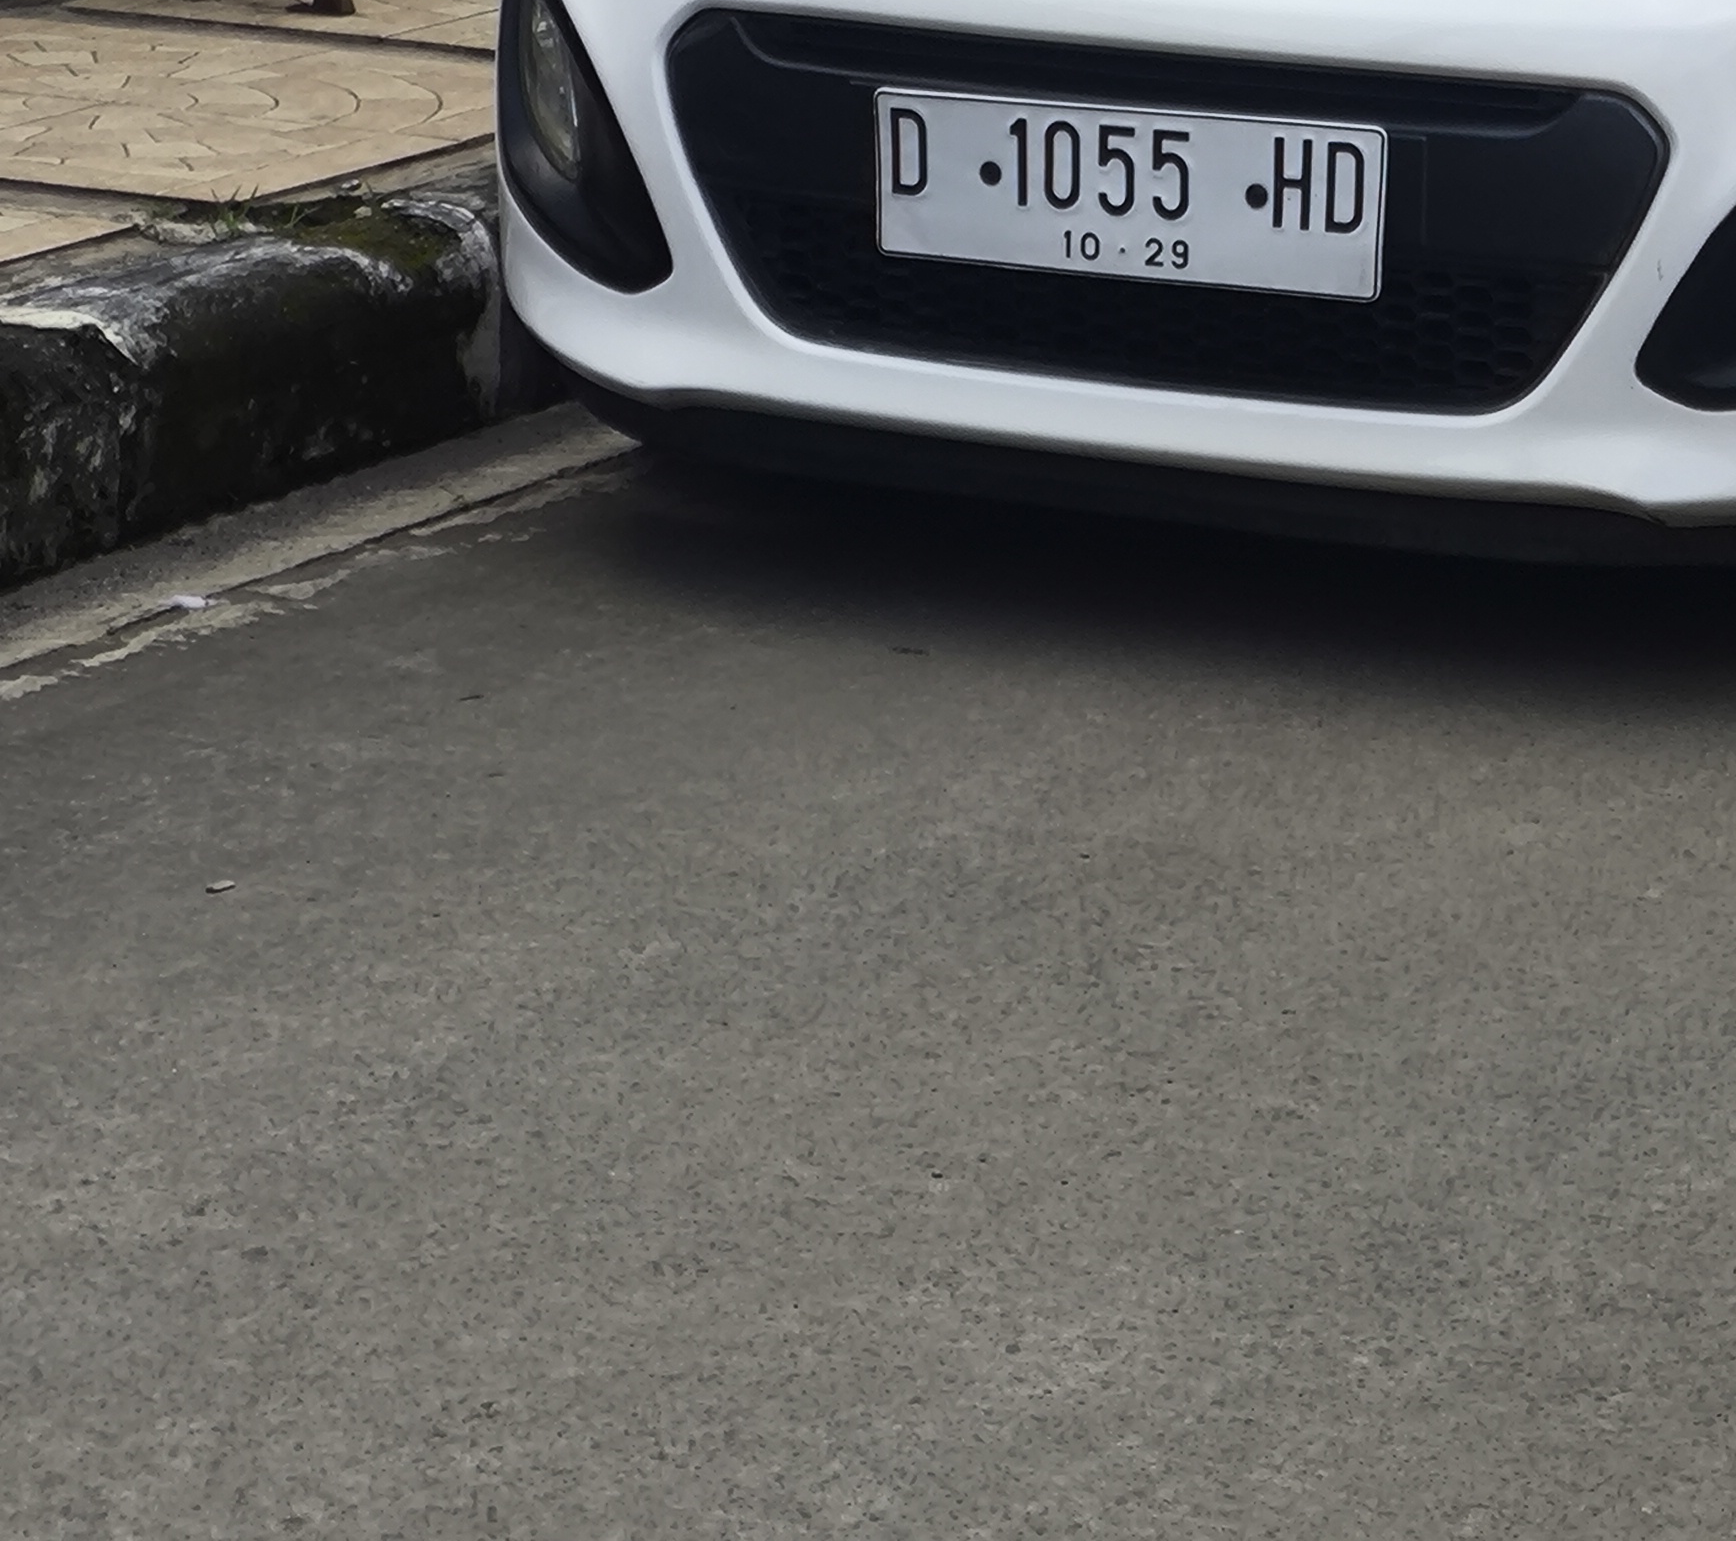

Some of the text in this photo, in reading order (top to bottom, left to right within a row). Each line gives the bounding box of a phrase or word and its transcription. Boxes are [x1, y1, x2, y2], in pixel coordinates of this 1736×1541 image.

[890, 107, 1364, 234] D 1055 HD
